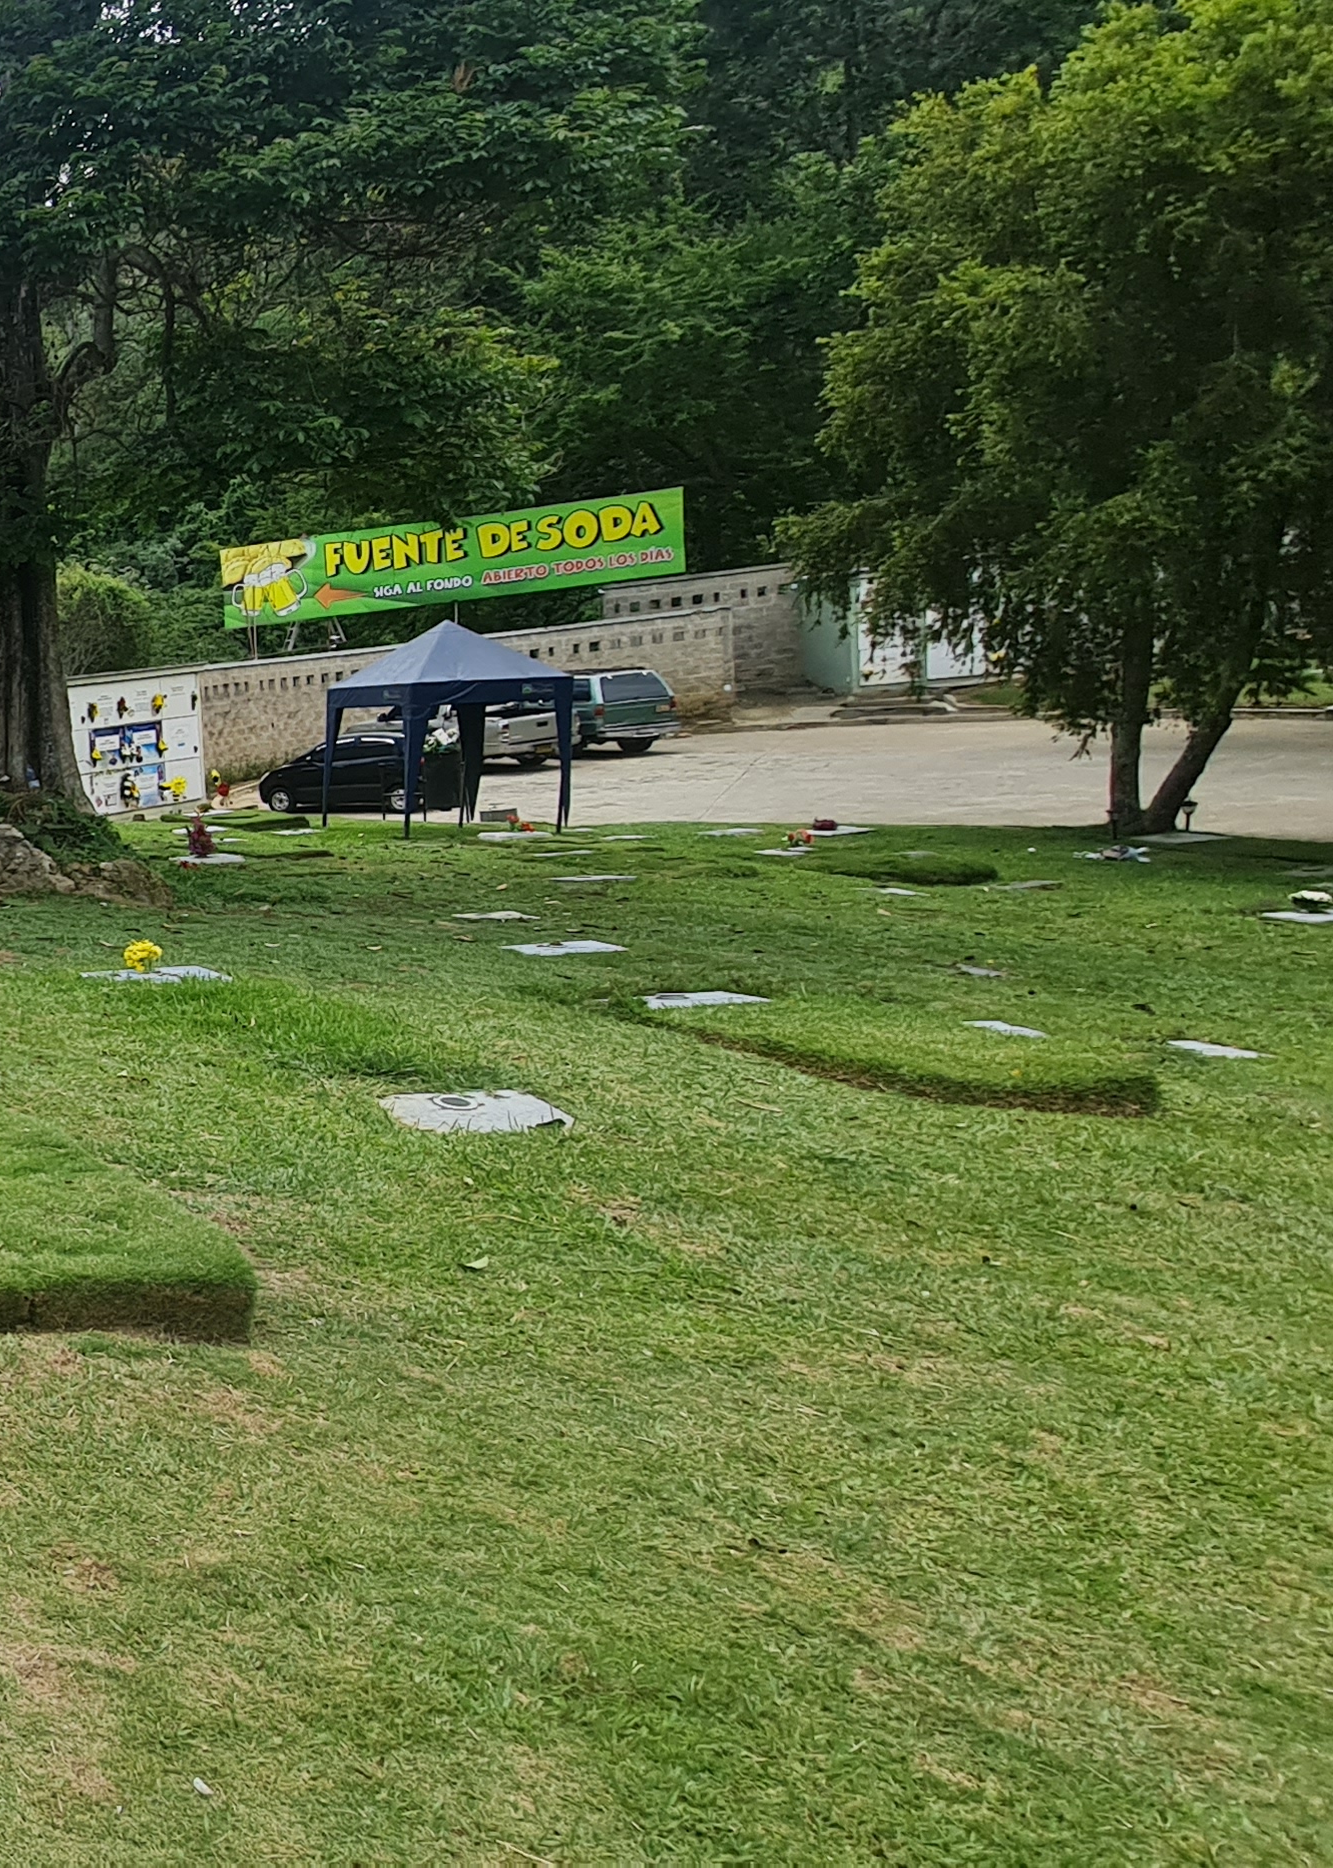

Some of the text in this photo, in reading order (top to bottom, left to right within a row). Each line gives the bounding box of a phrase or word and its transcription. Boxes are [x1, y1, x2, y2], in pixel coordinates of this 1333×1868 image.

[324, 500, 664, 578] FUENTE DE SODA
[373, 583, 404, 598] SIGA
[407, 581, 423, 594] AL
[426, 575, 473, 592] FONDO
[482, 564, 548, 585] ABIERTO
[552, 556, 604, 574] TODOS
[608, 552, 635, 568] LOS
